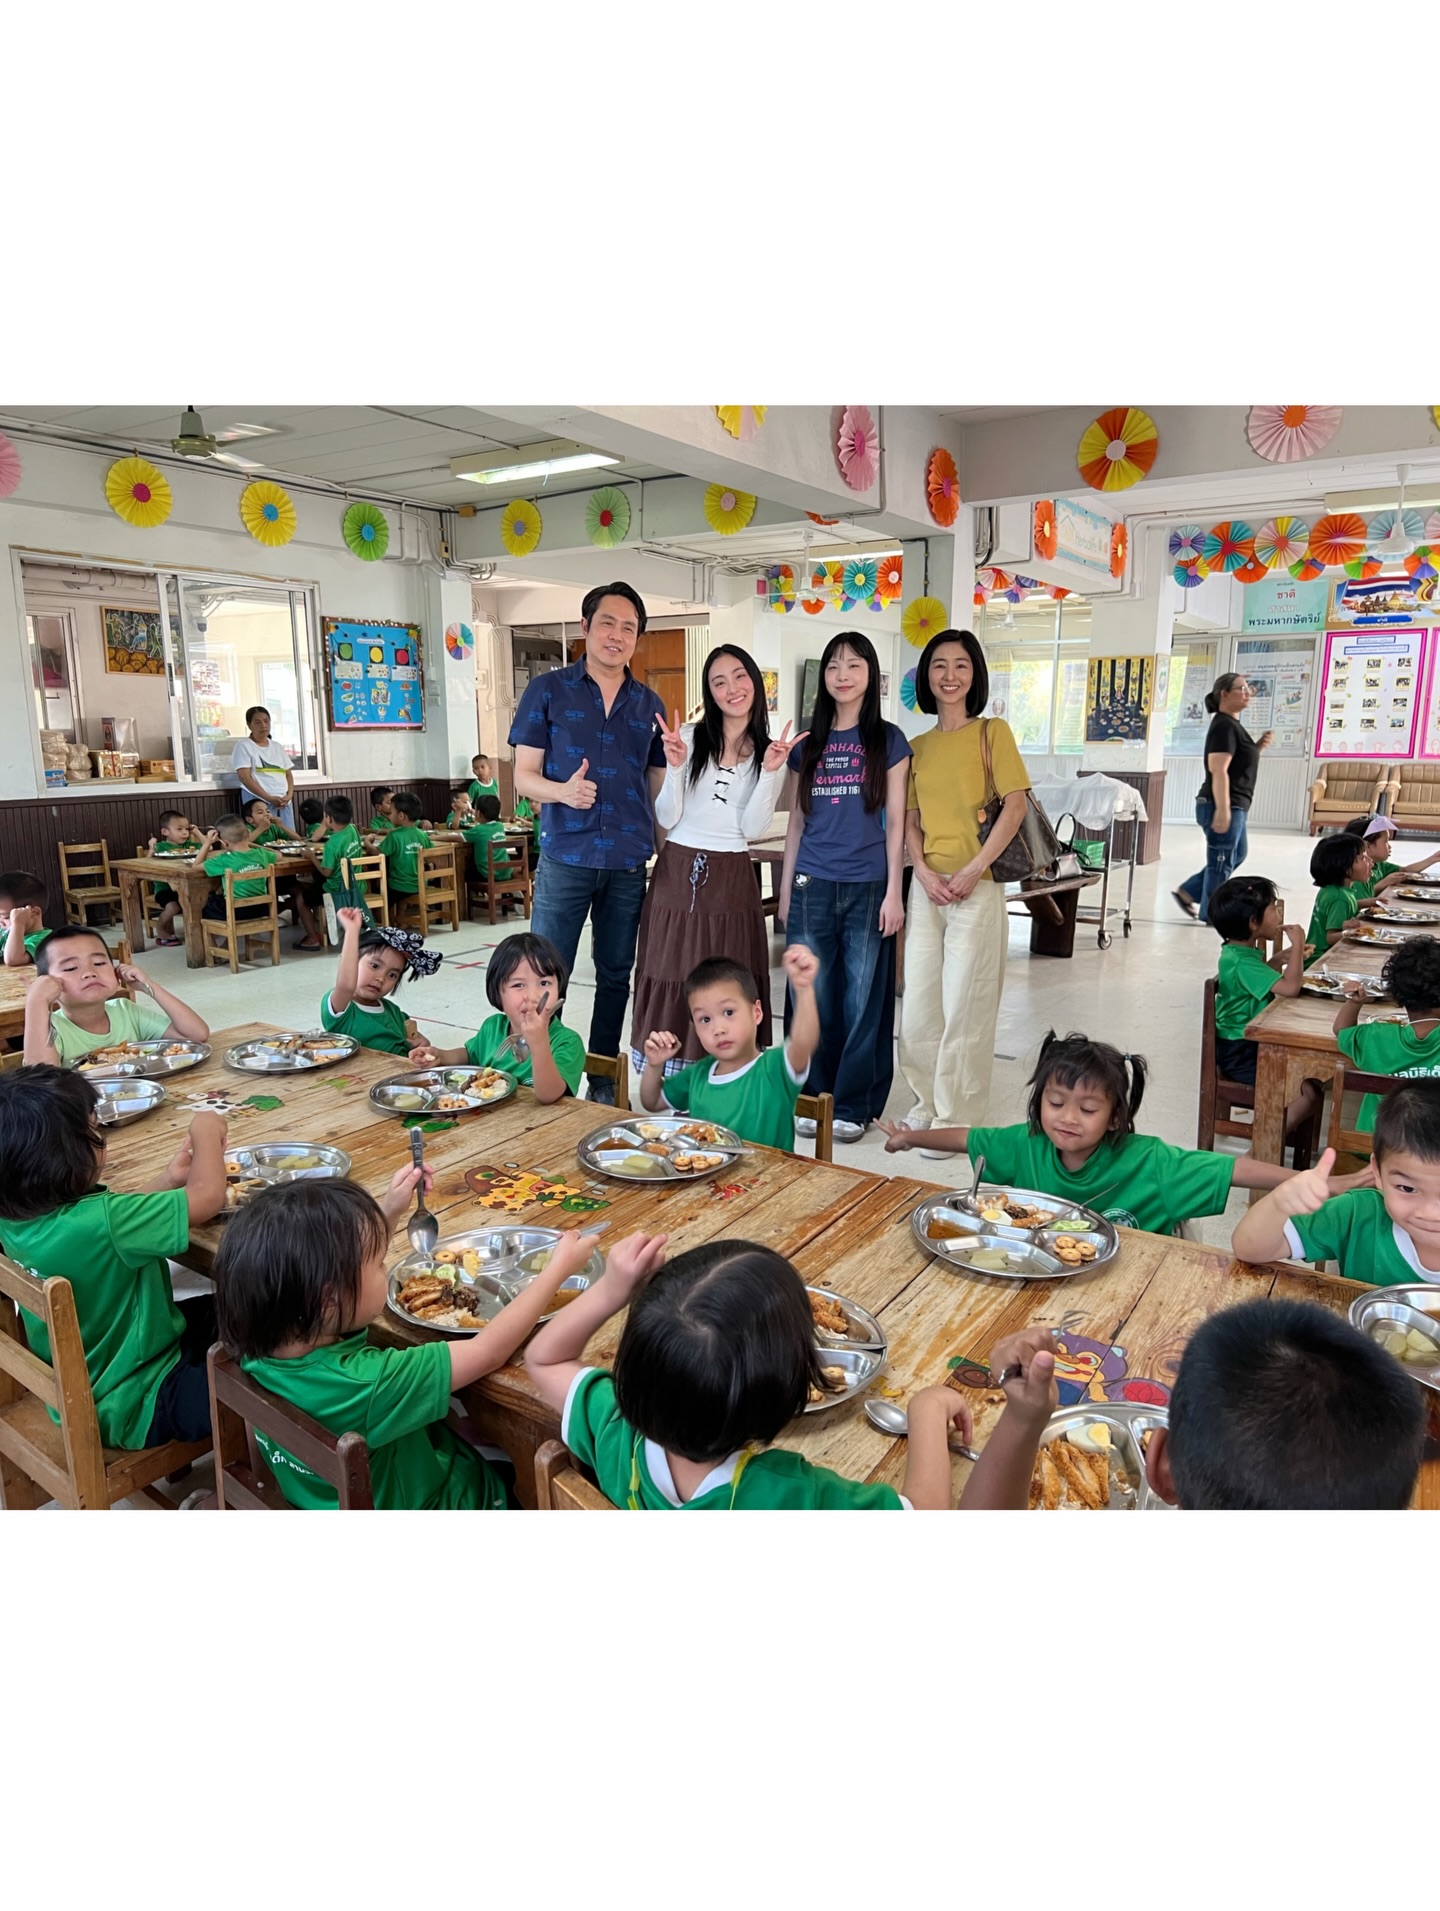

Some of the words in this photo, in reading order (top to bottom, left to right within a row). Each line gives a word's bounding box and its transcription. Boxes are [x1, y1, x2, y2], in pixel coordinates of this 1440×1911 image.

[1277, 588, 1296, 599] ชาติ
[1248, 612, 1321, 626] พระมหากษัตริย์
[814, 766, 866, 785] enmark
[812, 786, 847, 796] ESTABLISHED
